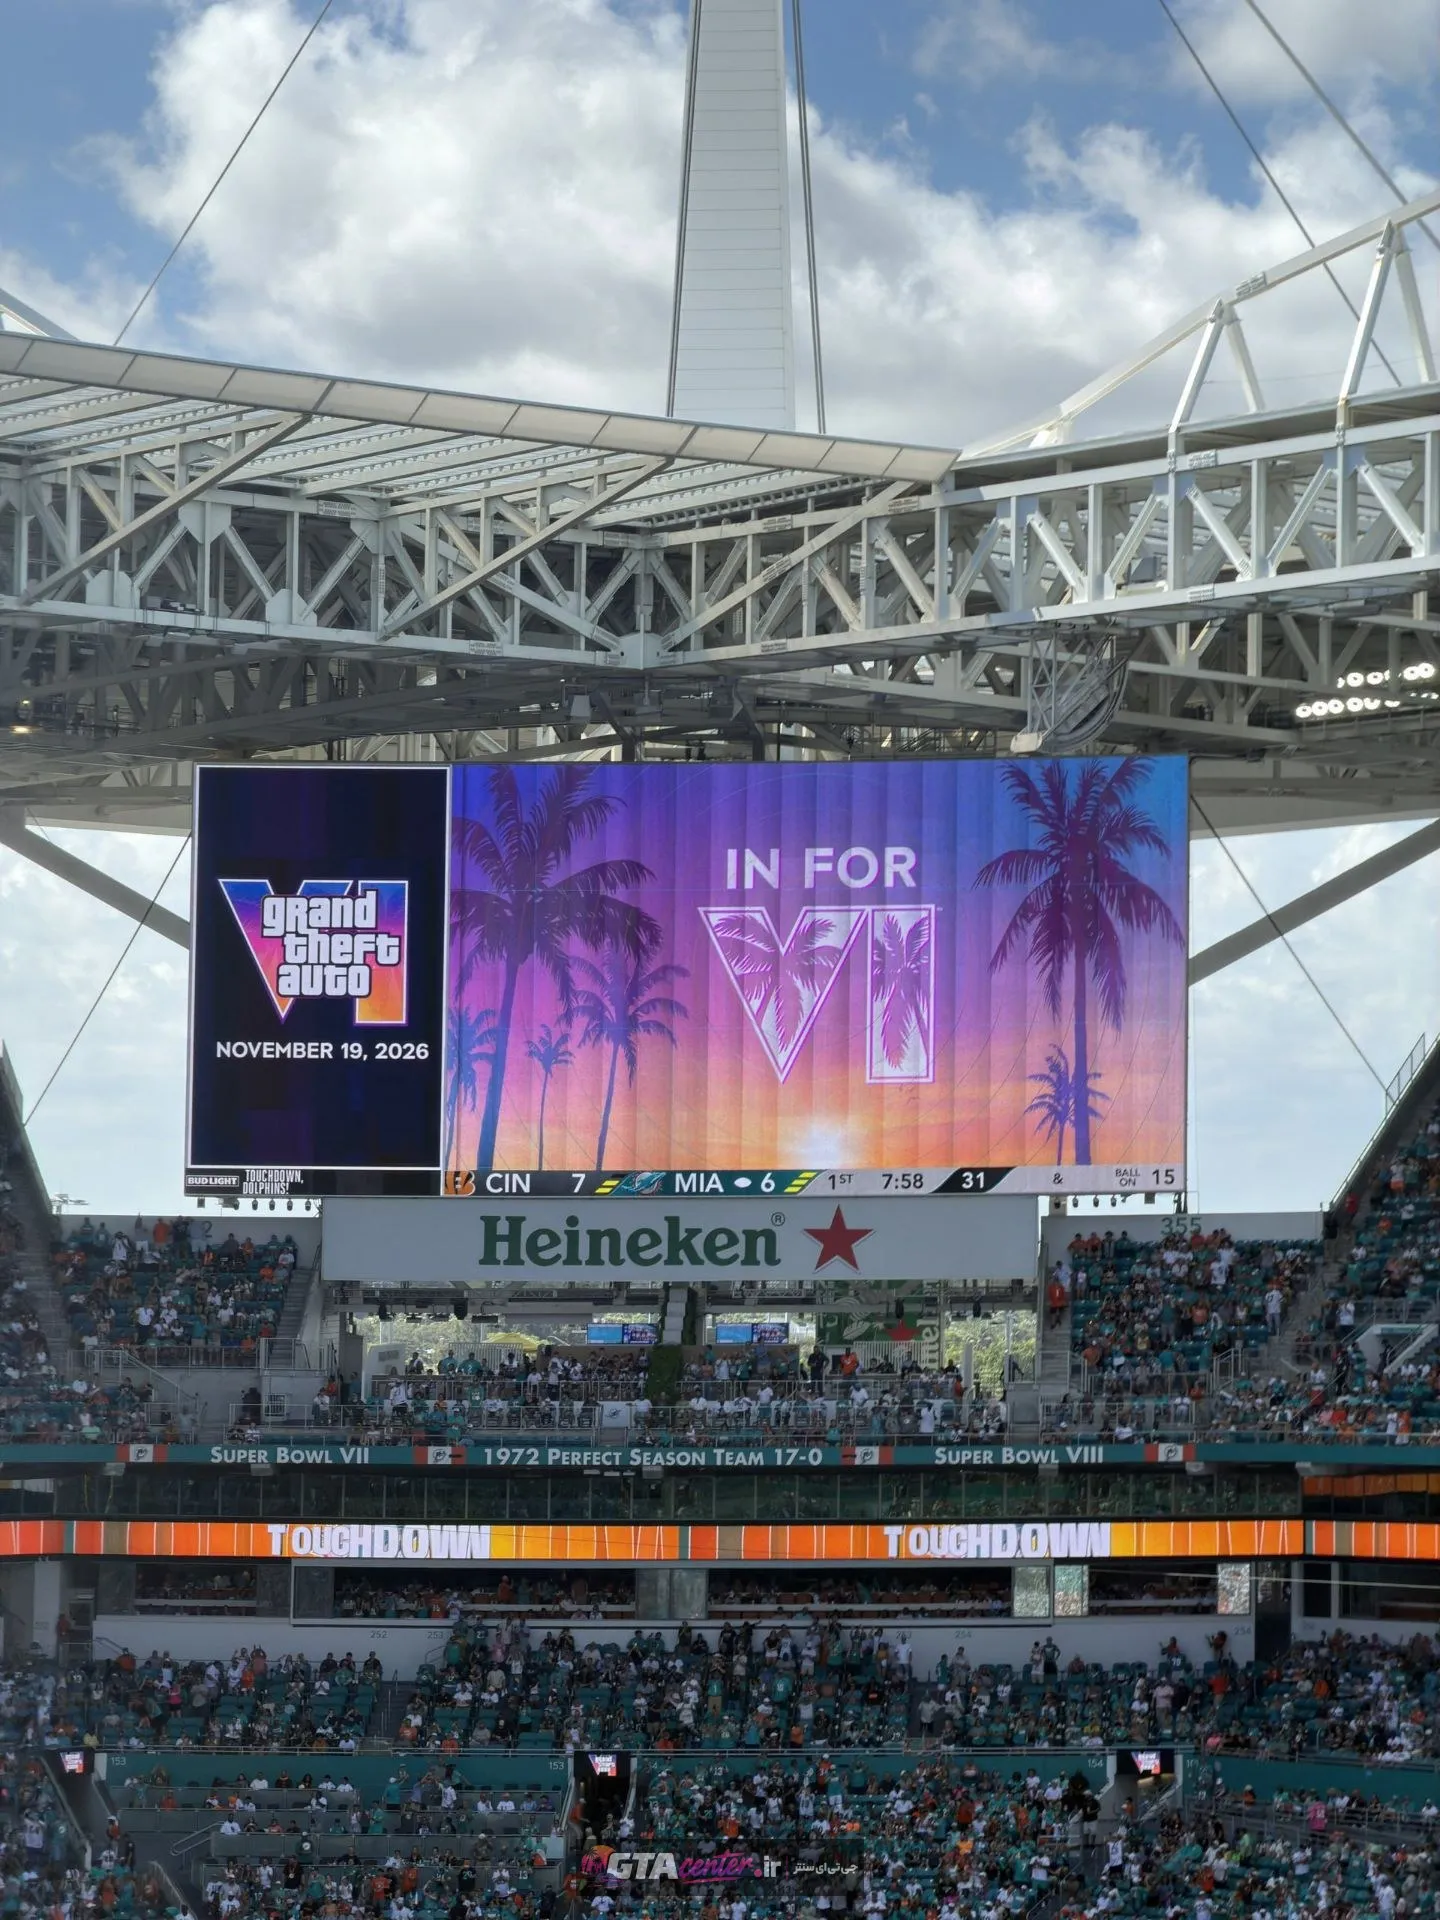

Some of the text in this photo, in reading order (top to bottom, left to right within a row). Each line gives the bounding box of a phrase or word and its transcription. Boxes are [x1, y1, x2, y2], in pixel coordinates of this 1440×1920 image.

[727, 847, 916, 889] IN FOR
[277, 964, 372, 998] auto
[698, 904, 935, 1084] VI
[216, 1041, 430, 1062] NOVEMBER 19, 2026
[209, 1177, 238, 1186] LIGHT
[245, 1169, 304, 1184] TOUCHDOWN,
[827, 1173, 924, 1190] 1ST 7:58
[961, 1172, 985, 1189] 31
[1052, 1173, 1064, 1185] &
[1114, 1168, 1141, 1178] BALL
[1118, 1177, 1137, 1187] ON
[1151, 1169, 1175, 1185] 15
[242, 1182, 290, 1195] DOLPHINS!
[485, 1173, 586, 1194] CIN 7
[674, 1174, 776, 1193] MIA 6
[1161, 1217, 1203, 1236] 355
[478, 1214, 783, 1267] Heineken
[210, 1446, 370, 1464] SUPER BOWL VII
[484, 1448, 823, 1466] 1972 PERFECT SEASON TEAM 17-0
[934, 1446, 1104, 1465] SUPER BOWL VIII
[266, 1524, 491, 1559] TOUCHDOWN
[883, 1522, 1111, 1558] TOUCHDOWN
[110, 1756, 127, 1766] 153
[548, 1761, 565, 1771] 153
